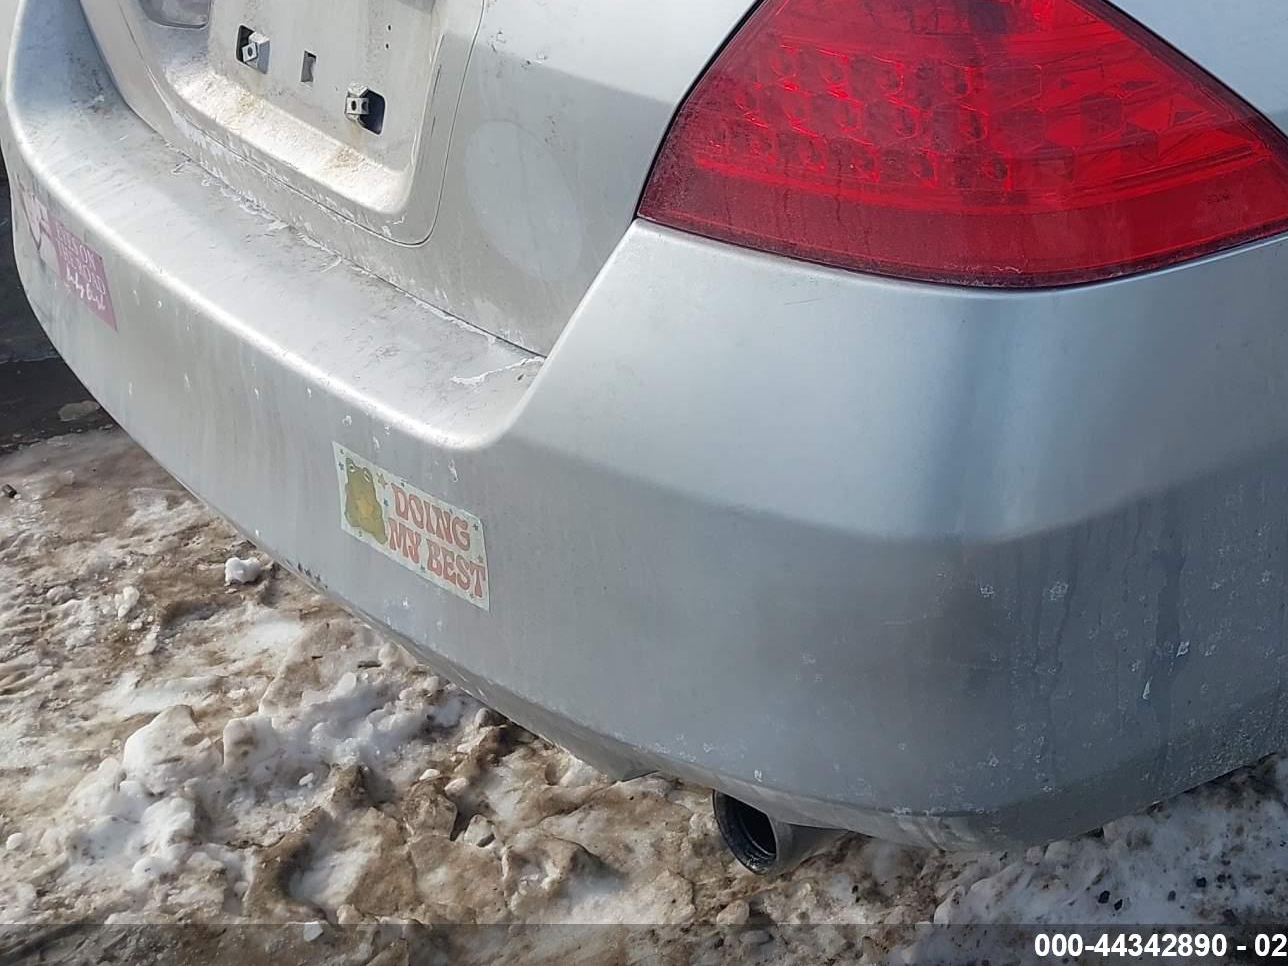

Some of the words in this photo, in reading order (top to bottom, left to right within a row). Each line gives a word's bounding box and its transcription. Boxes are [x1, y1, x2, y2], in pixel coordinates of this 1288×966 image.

[390, 482, 471, 552] DOING
[388, 517, 422, 563] MY
[426, 538, 486, 599] BEST
